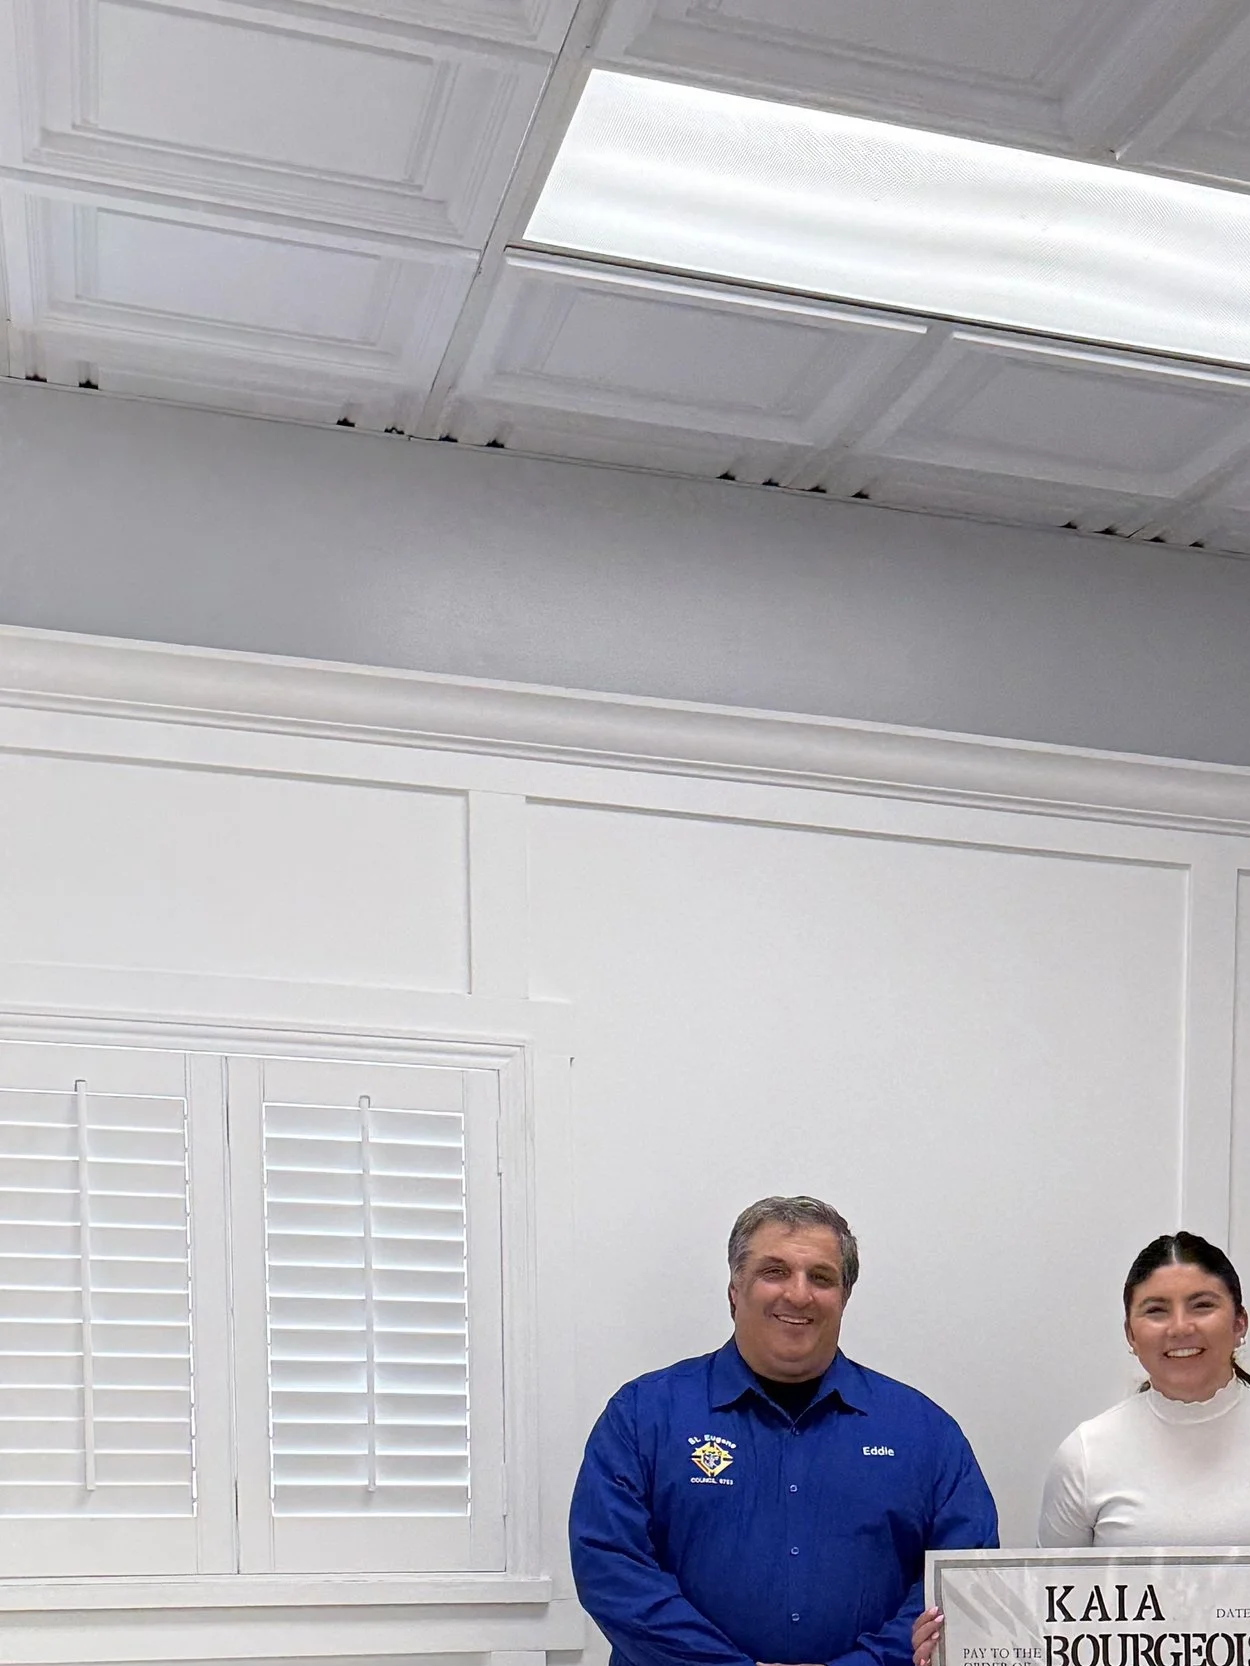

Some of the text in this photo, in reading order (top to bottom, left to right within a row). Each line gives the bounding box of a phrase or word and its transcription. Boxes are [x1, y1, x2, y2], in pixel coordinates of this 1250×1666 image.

[862, 1446, 895, 1457] Eddie
[1045, 1584, 1166, 1622] KAIA
[963, 1647, 1042, 1660] PAY TO THE
